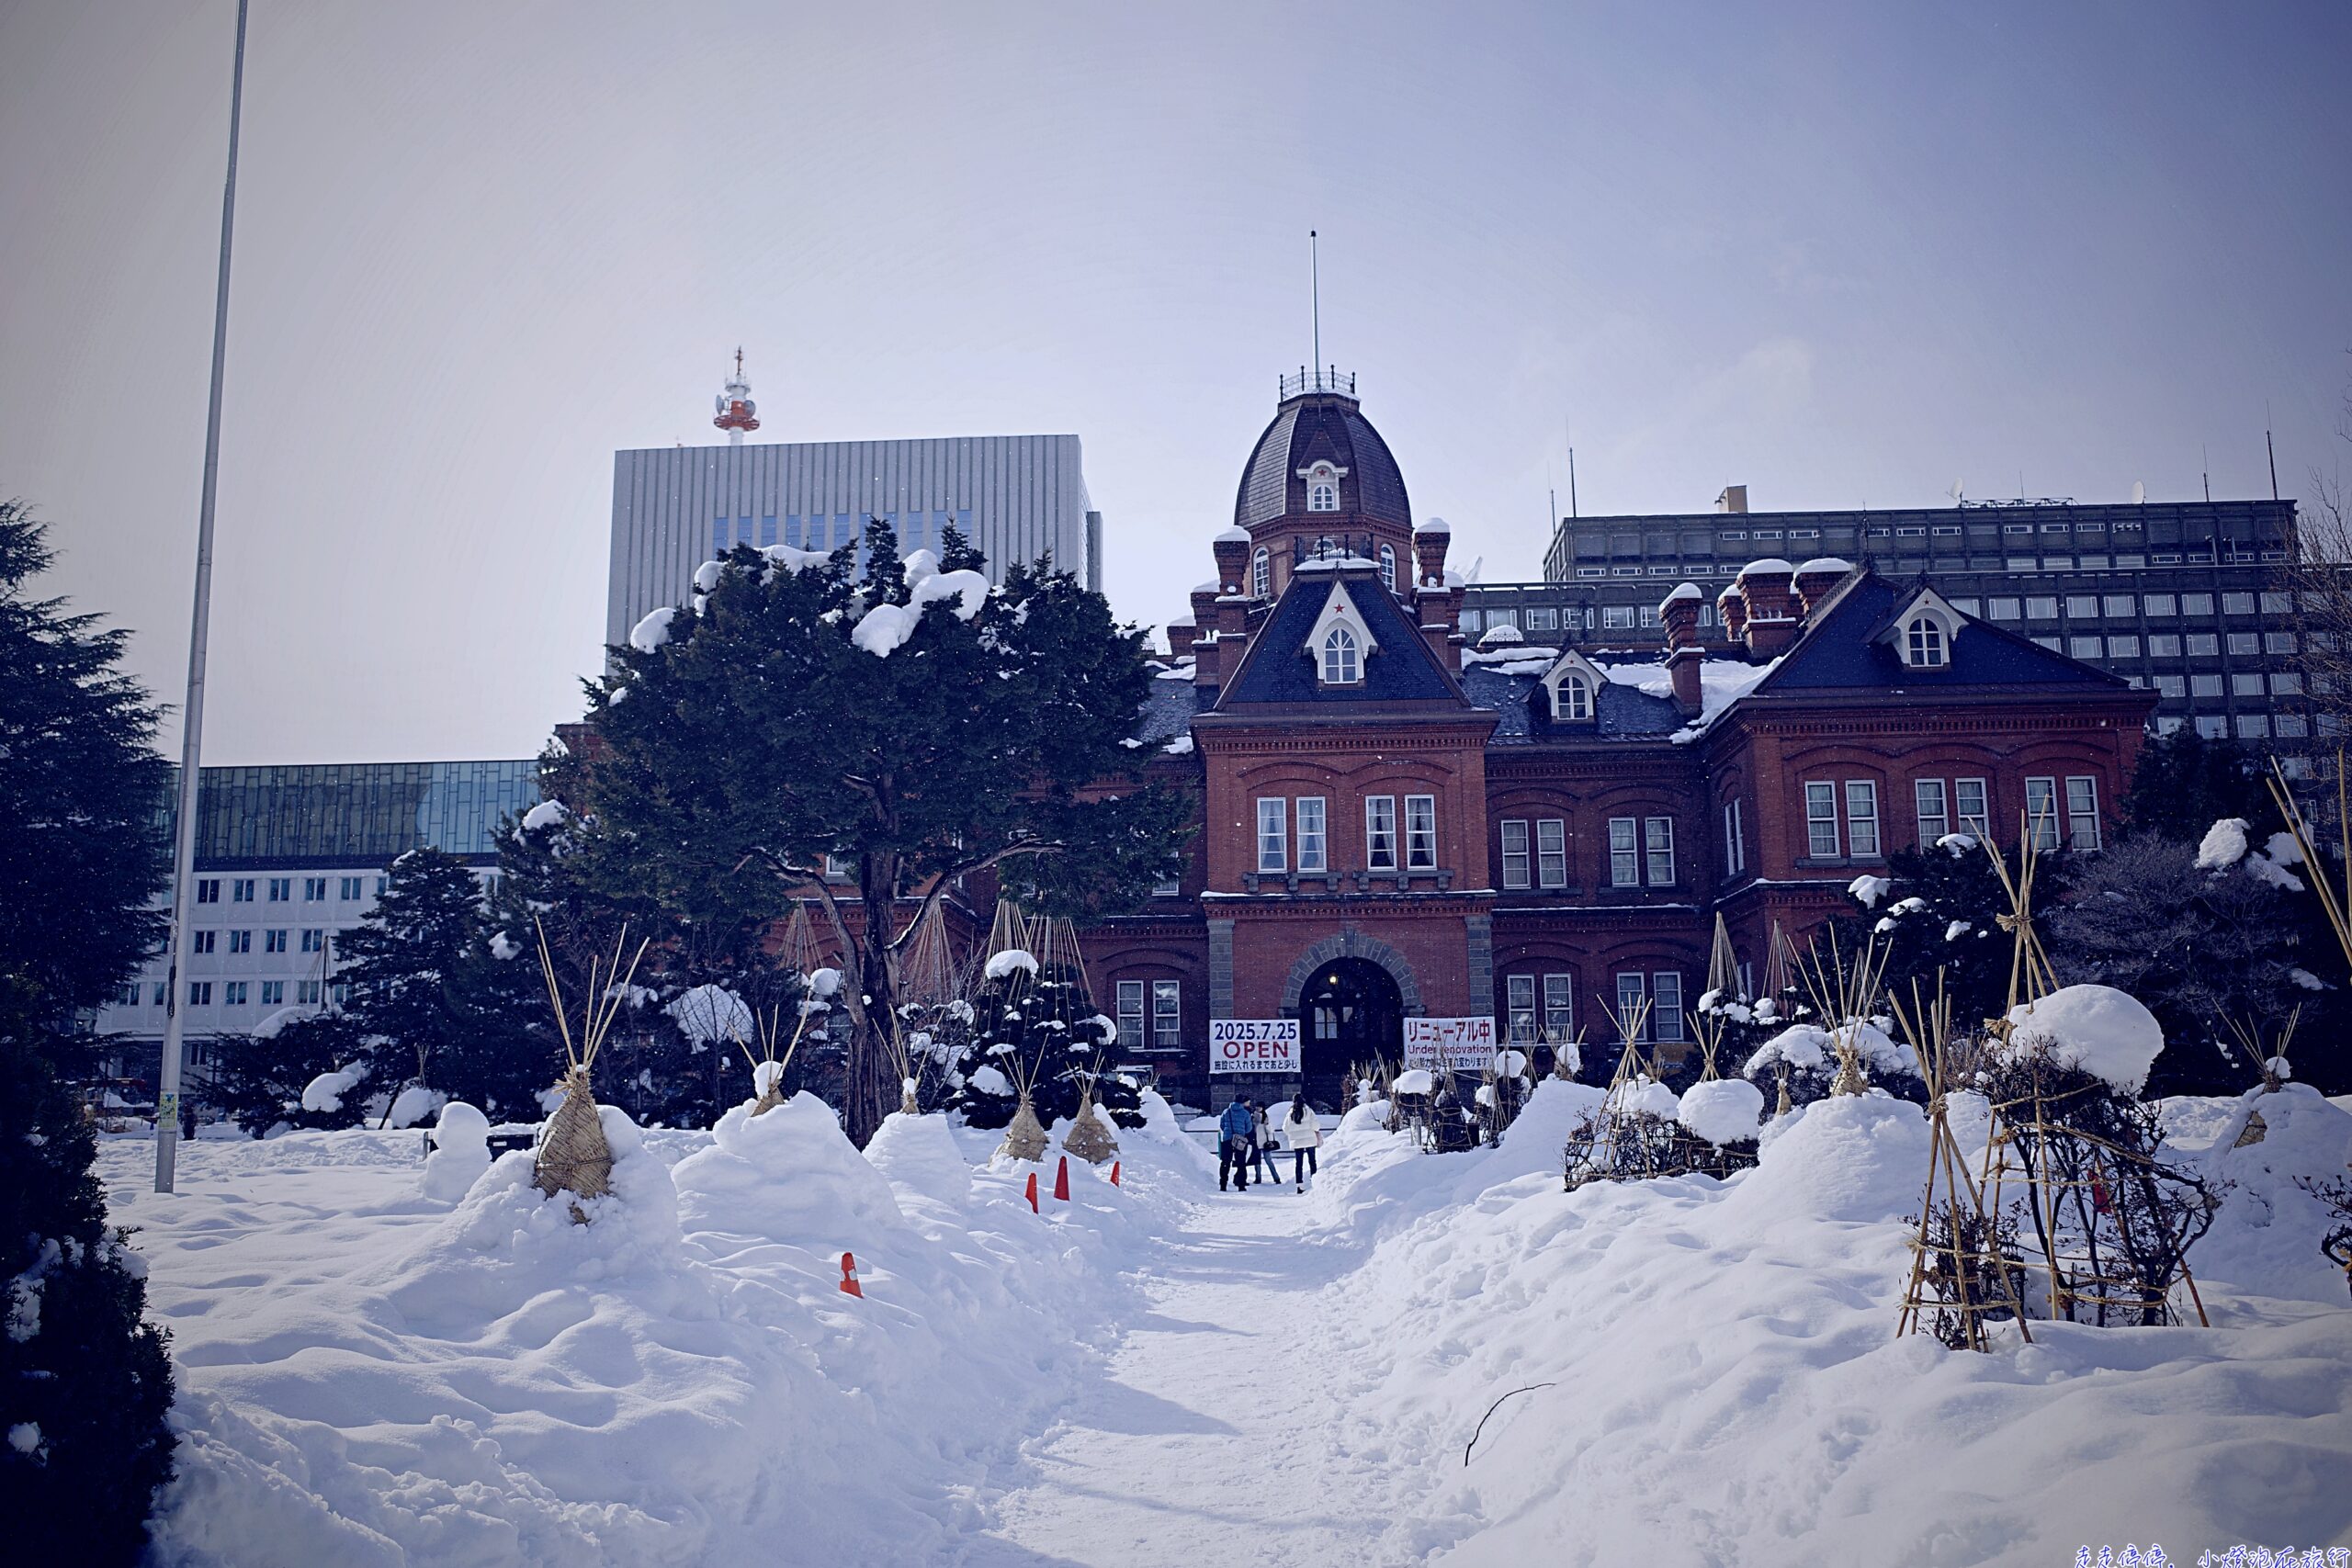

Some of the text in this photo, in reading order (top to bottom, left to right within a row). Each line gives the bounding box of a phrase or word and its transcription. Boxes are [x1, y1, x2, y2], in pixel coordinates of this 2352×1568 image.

[1215, 1022, 1296, 1040] 2025.7.25
[1408, 1020, 1490, 1043] リニューアル中
[1223, 1041, 1288, 1058] OPEN
[1408, 1043, 1491, 1055] Under enovation
[1215, 1060, 1297, 1070] 施設に入れるまであと少し
